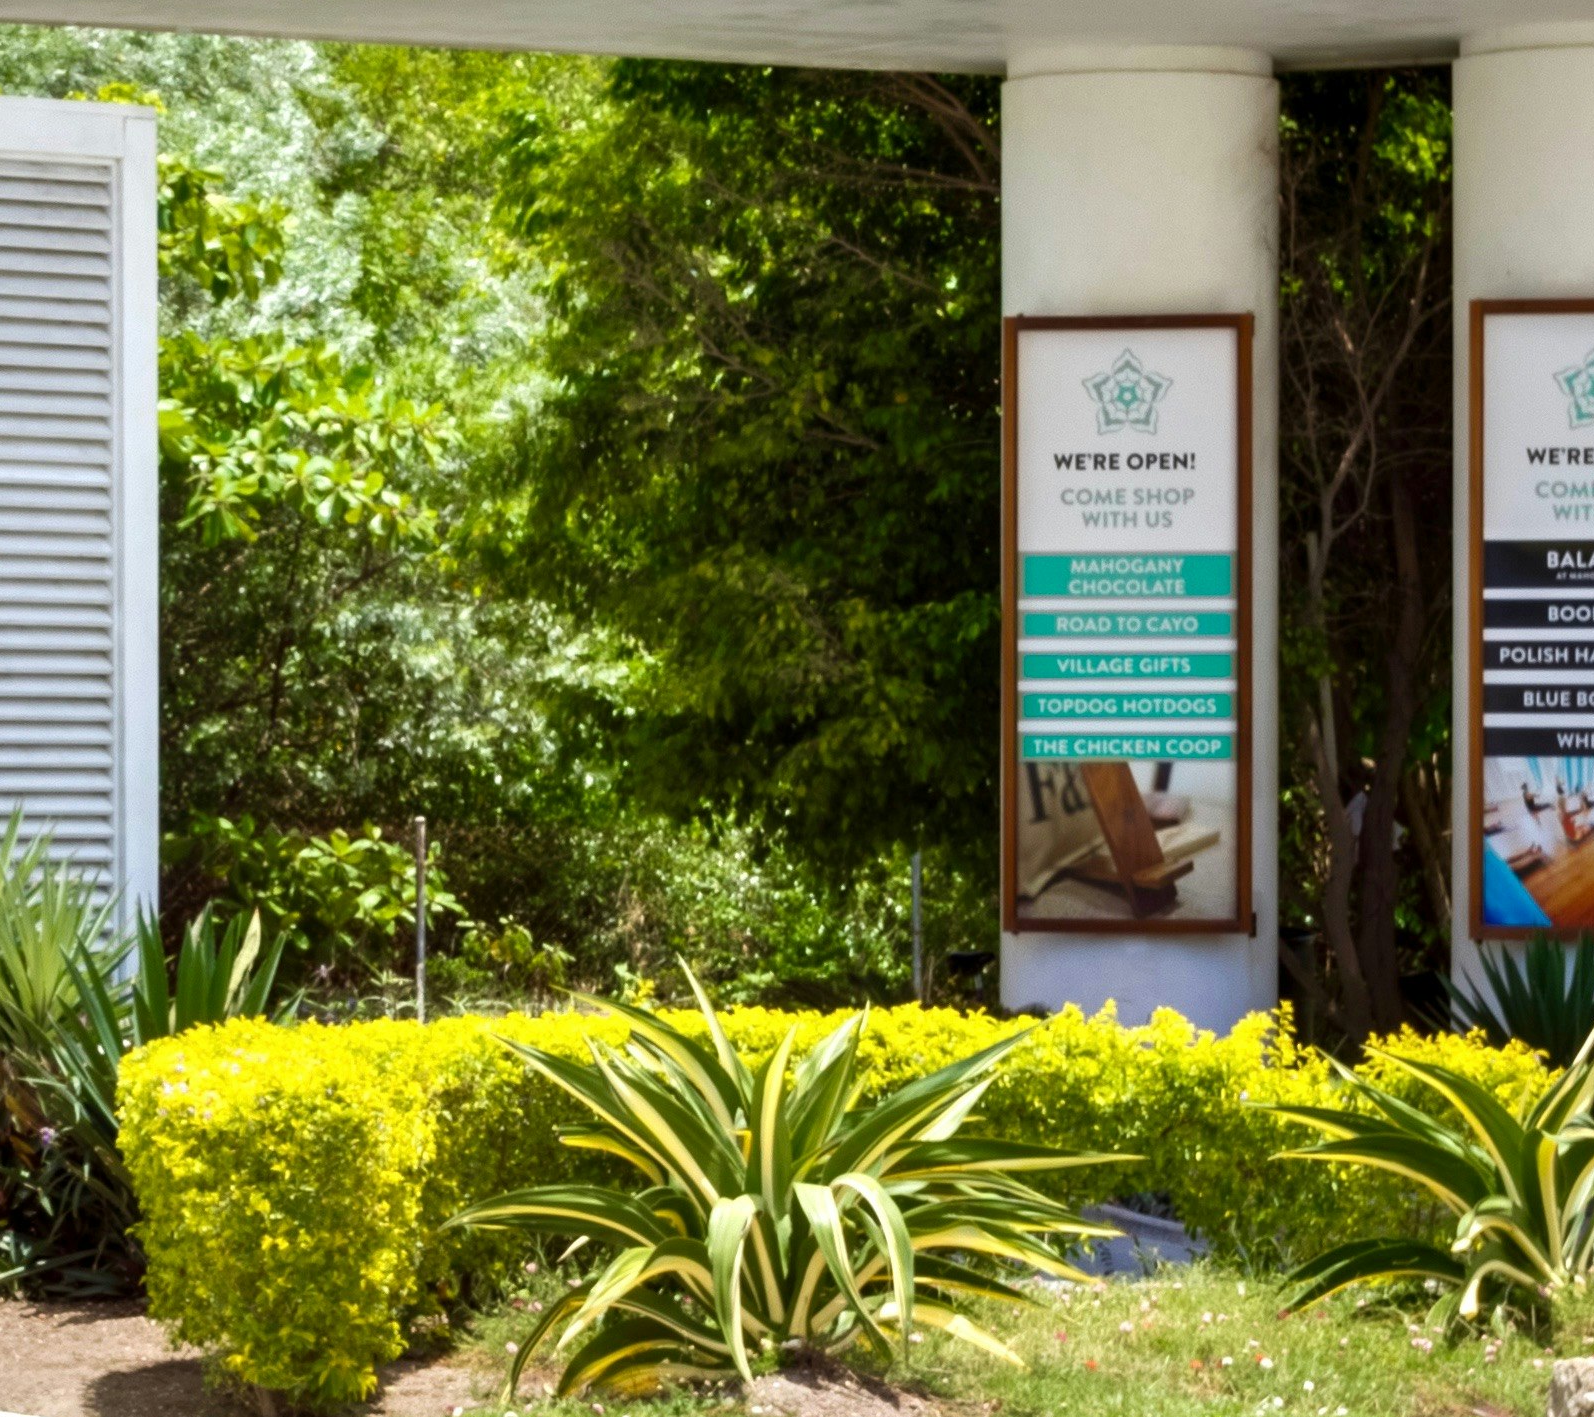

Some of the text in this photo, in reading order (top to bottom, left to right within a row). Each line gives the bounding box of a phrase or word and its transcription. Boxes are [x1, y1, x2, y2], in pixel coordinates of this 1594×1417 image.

[1053, 452, 1196, 471] WE'RE OPEN!
[1526, 446, 1594, 466] WE'RE
[1060, 487, 1196, 506] COME SHOP
[1081, 510, 1174, 529] WITH US
[1069, 558, 1185, 575] MAHOGANY
[1067, 578, 1187, 596] CHOCOLATE
[1055, 616, 1199, 633] ROAD TO CAYO
[1498, 646, 1569, 665] POLISH
[1056, 657, 1192, 674] VILLAGE GIFTS
[1037, 698, 1217, 715] TOPDOG HOTDOGS
[1522, 690, 1571, 708] BLUE
[1033, 739, 1222, 755] THE CHICKEN COOP
